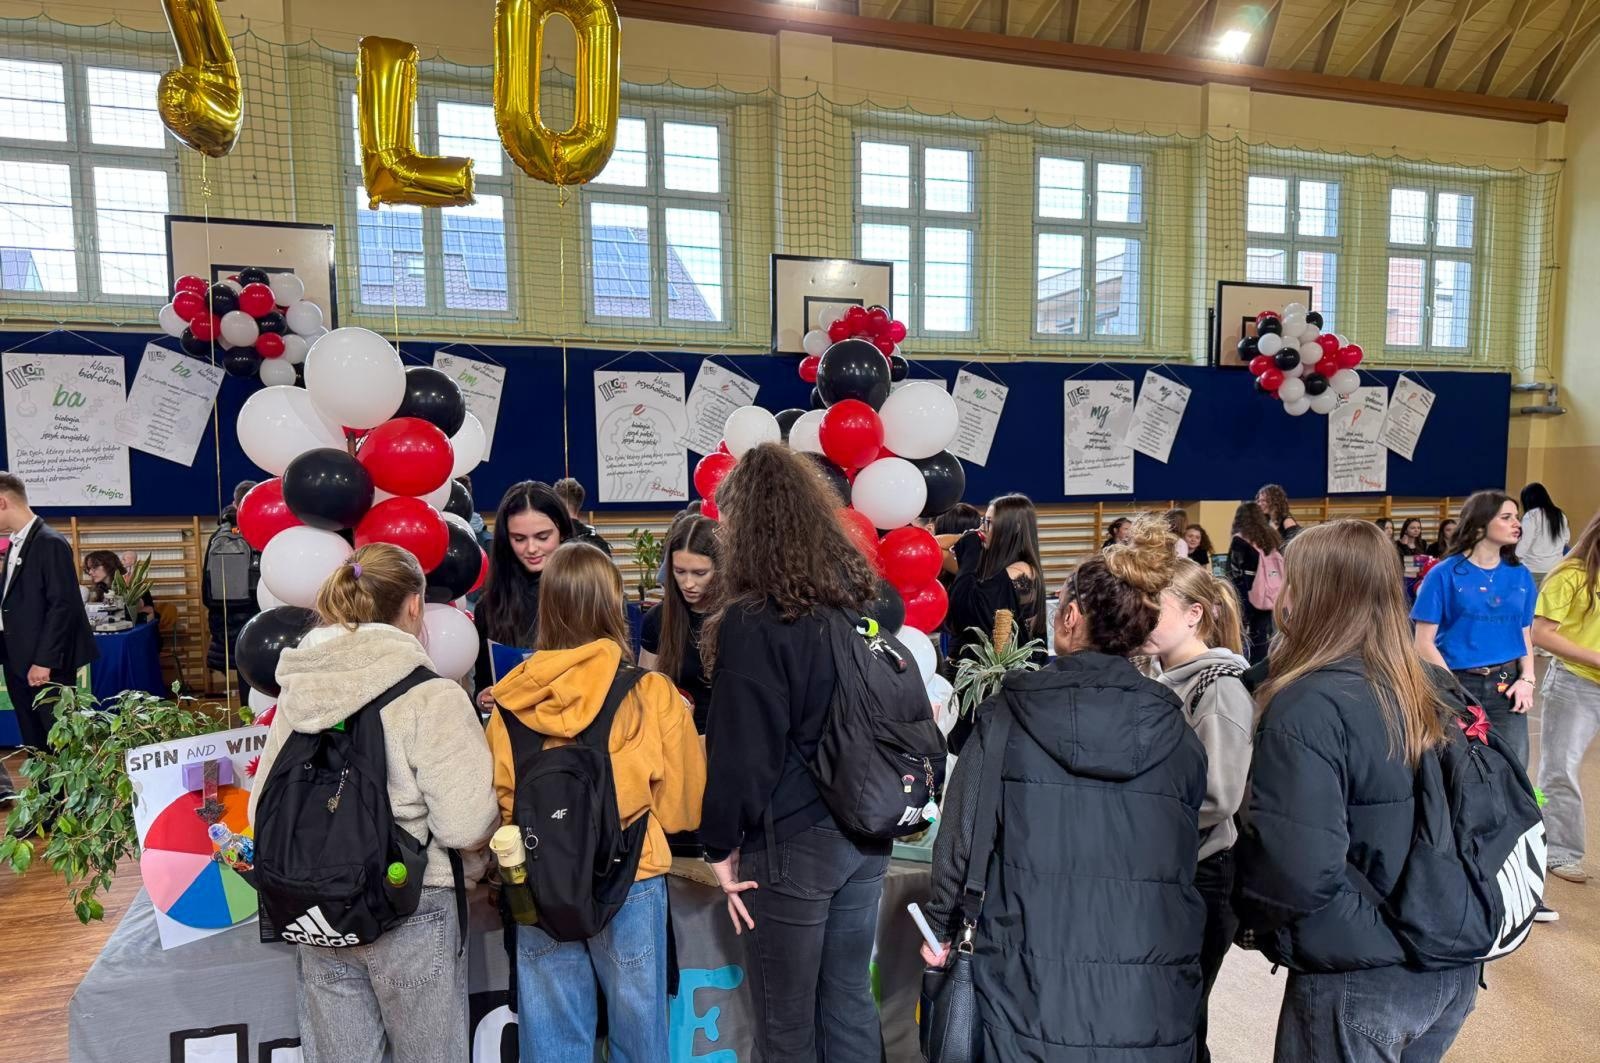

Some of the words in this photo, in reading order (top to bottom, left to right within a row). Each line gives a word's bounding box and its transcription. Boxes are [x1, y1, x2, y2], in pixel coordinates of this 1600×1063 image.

[78, 367, 122, 388] biol-chem
[170, 360, 193, 378] ba
[52, 384, 86, 408] ba
[54, 413, 80, 423] biologia
[85, 483, 98, 493] 16
[99, 487, 124, 499] miejsc
[130, 749, 178, 772] SPIN
[187, 744, 216, 760] AND
[226, 734, 267, 755] WIN
[551, 808, 568, 820] 4F
[281, 931, 360, 948] adidas
